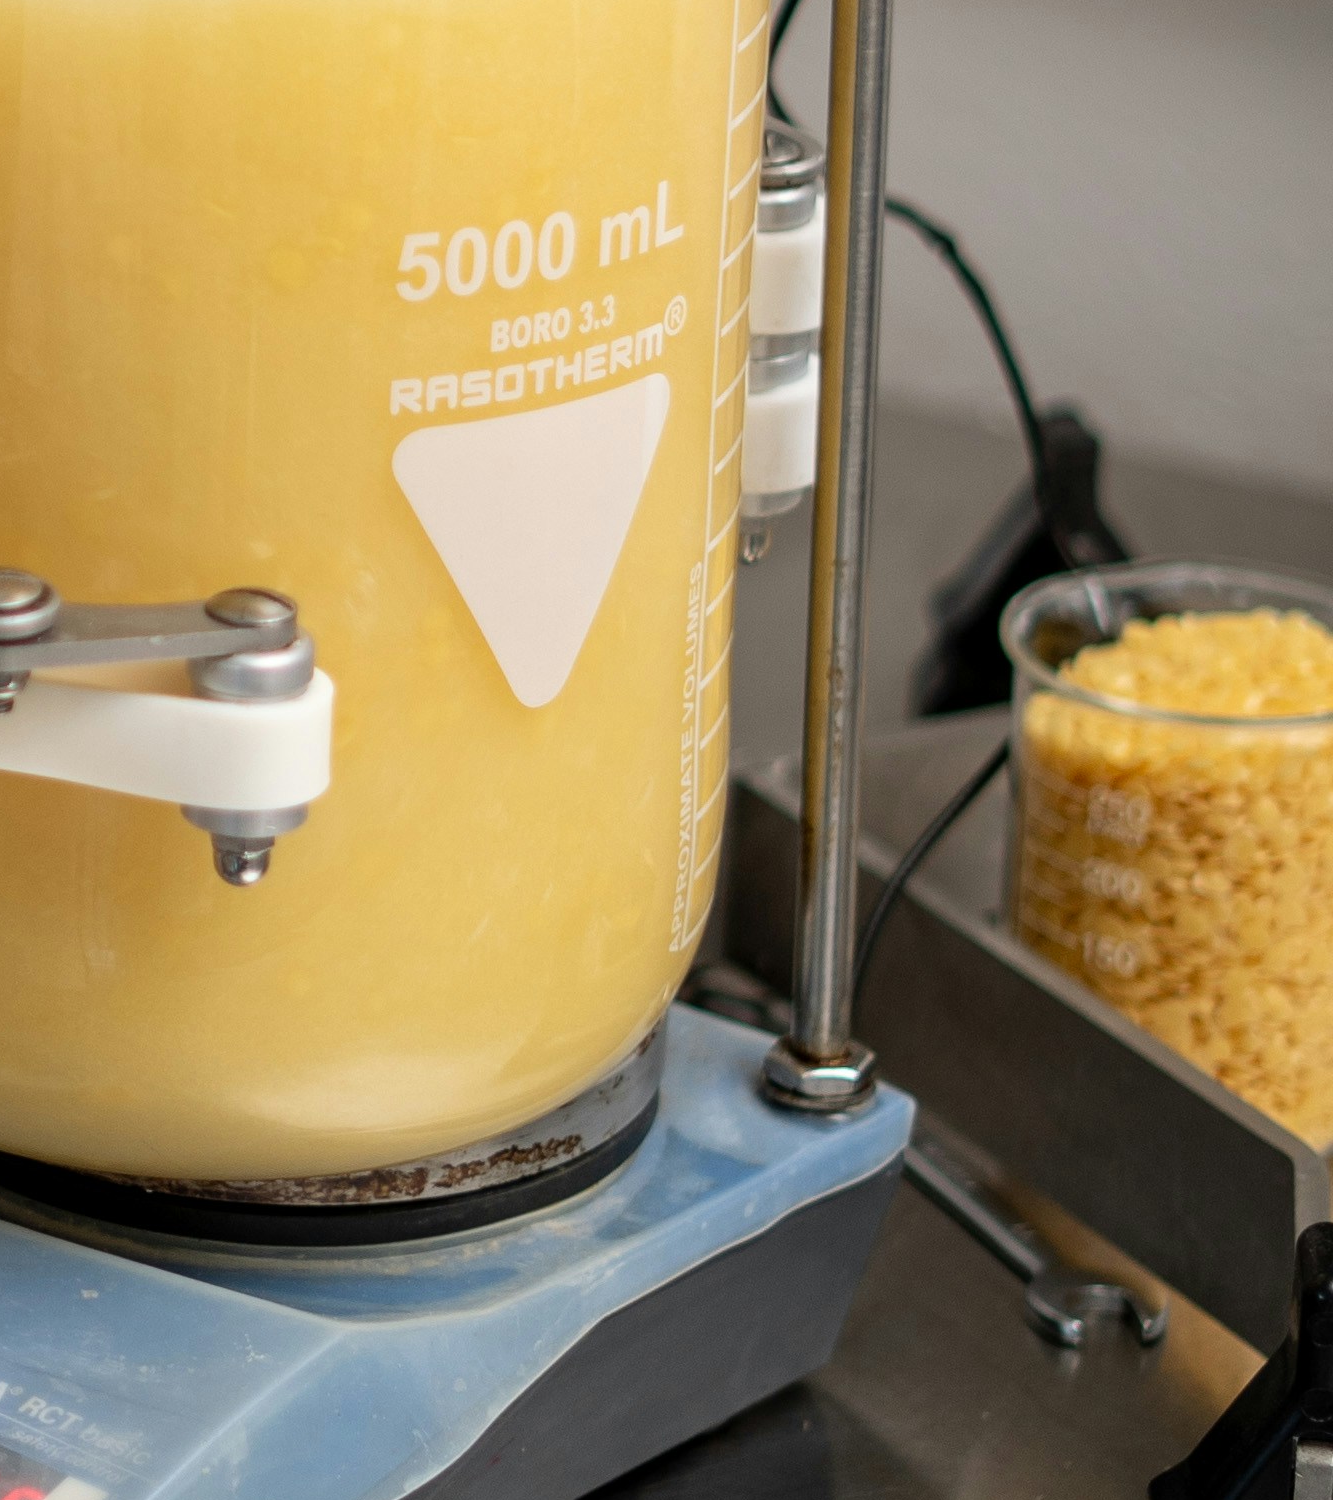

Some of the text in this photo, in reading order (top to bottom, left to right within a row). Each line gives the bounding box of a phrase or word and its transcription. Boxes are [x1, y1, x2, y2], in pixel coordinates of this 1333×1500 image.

[394, 180, 685, 302] 5000 mL
[489, 294, 616, 353] BORO 3.3
[668, 560, 704, 953] APPROXIMATE VOLUMES
[18, 1395, 84, 1432] RCT
